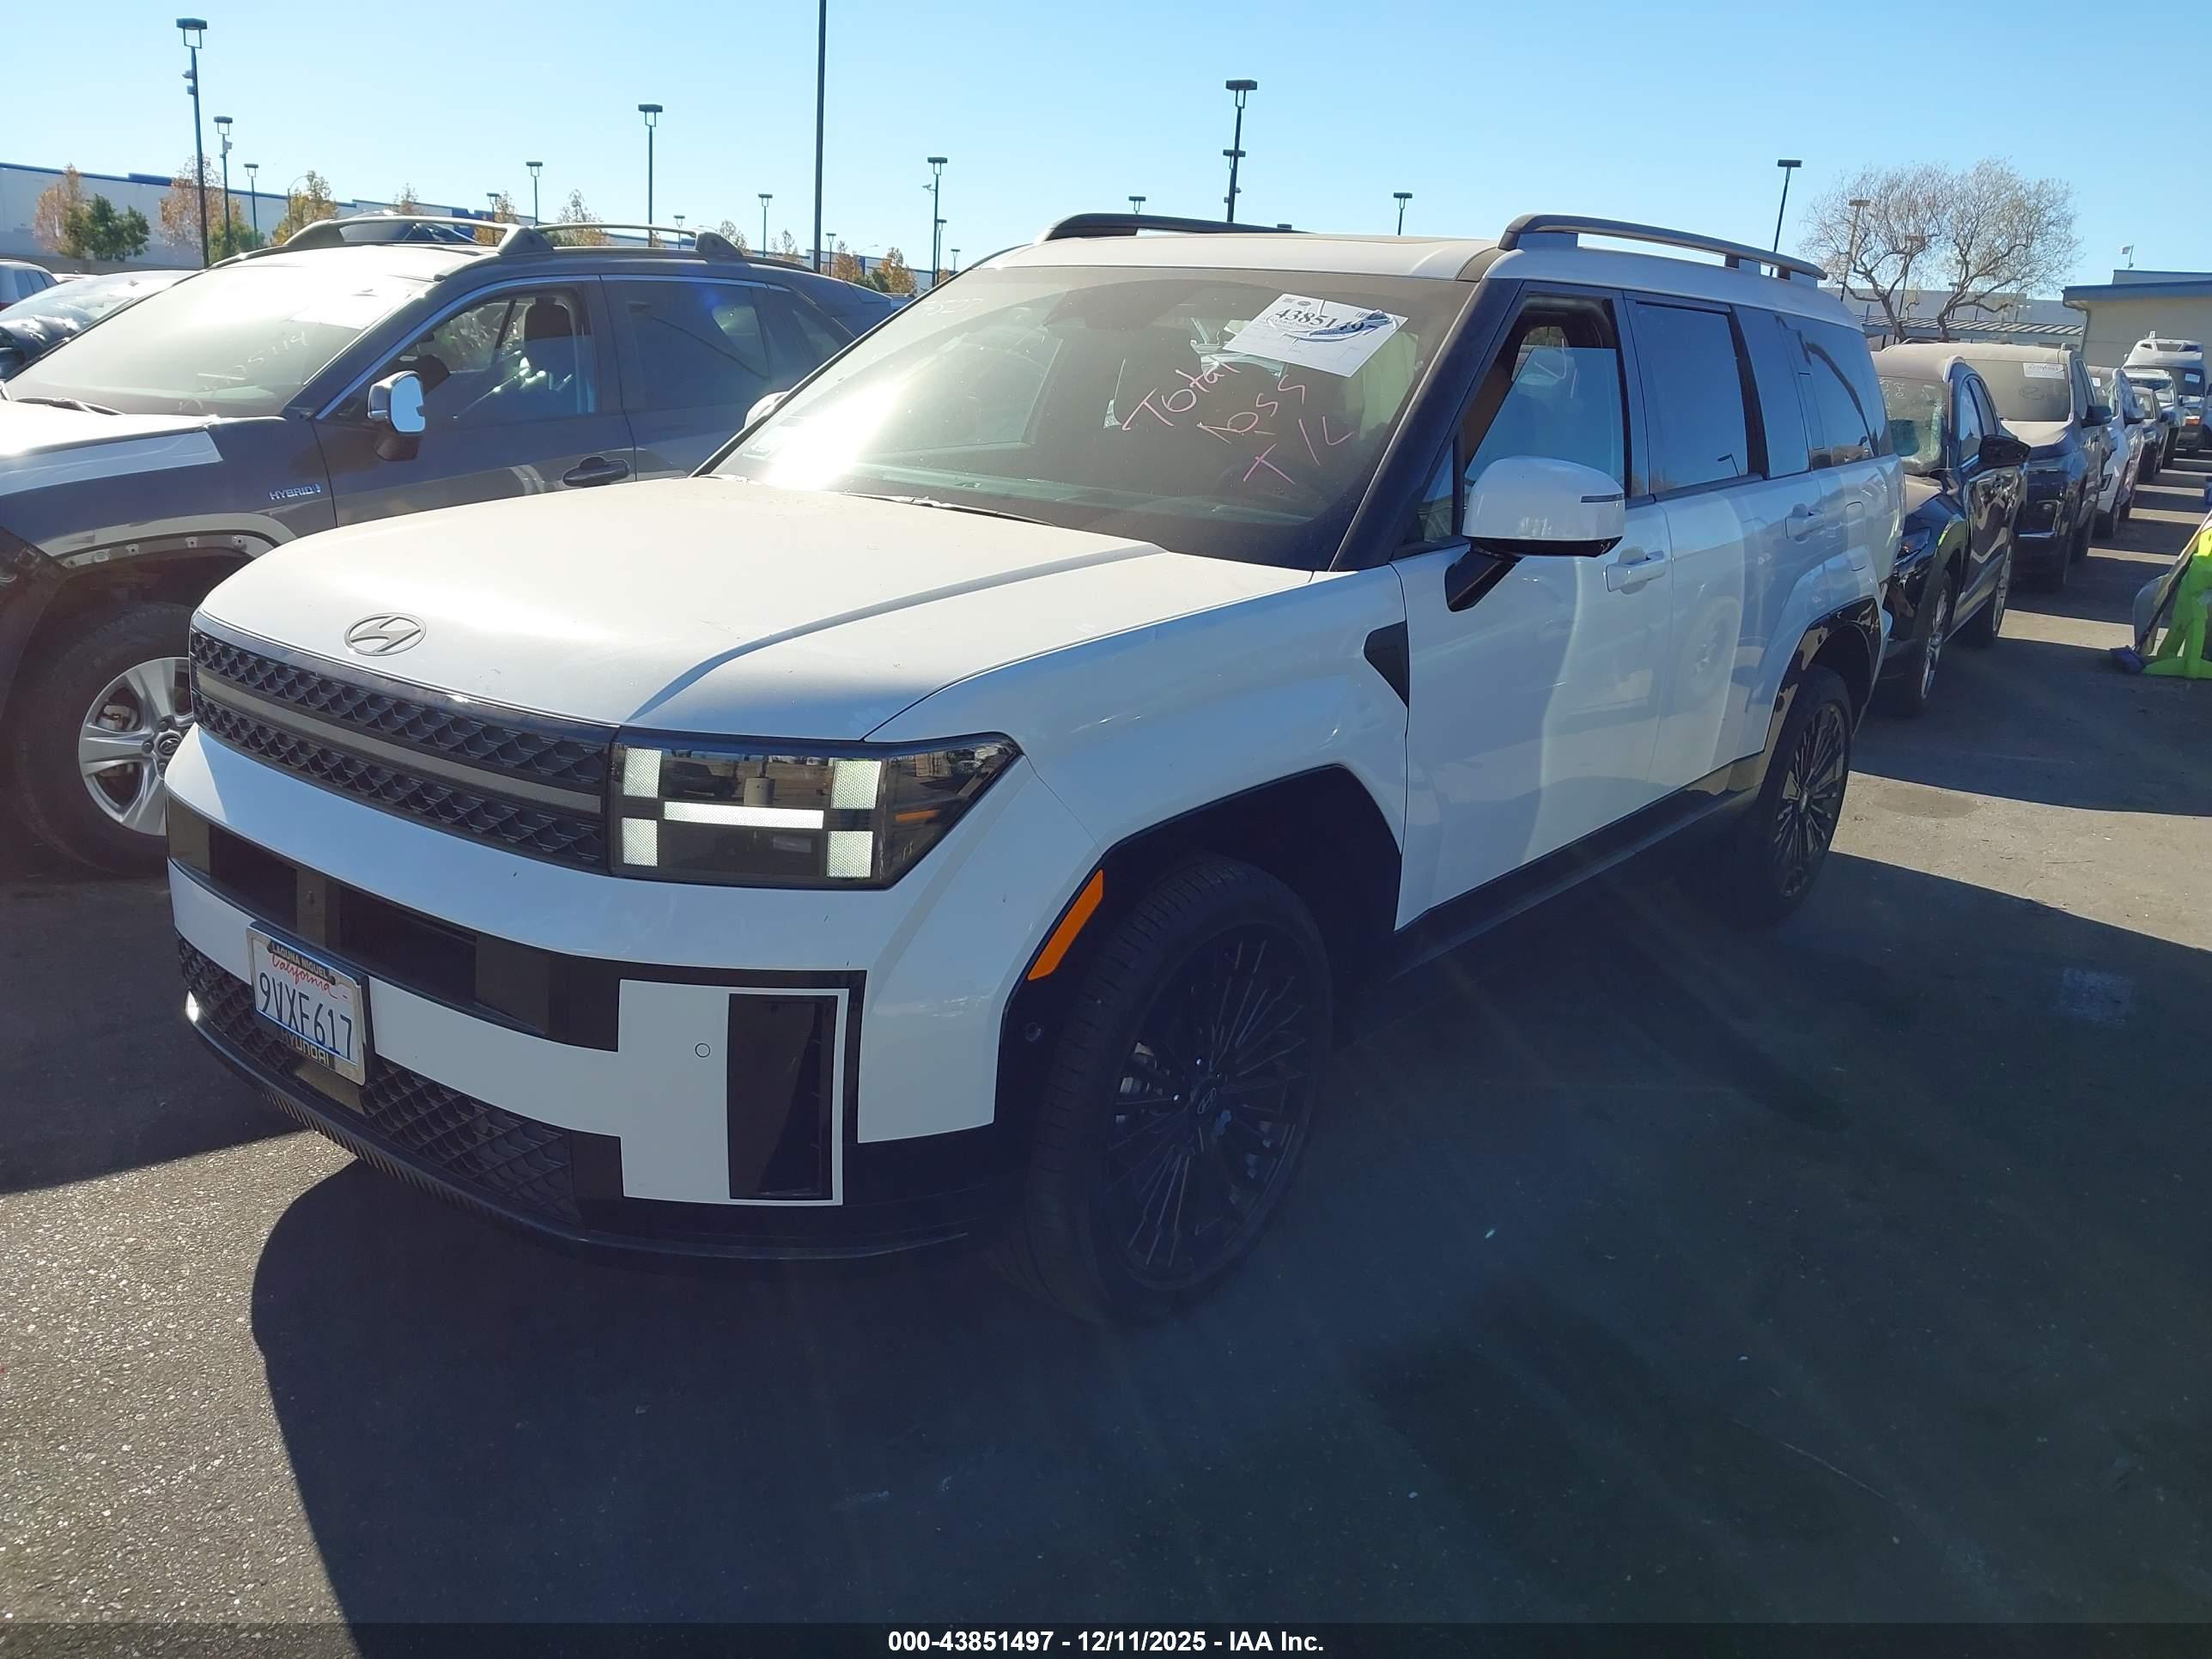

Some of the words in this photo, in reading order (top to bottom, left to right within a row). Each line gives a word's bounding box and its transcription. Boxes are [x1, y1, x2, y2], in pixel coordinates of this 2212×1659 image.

[268, 485, 314, 501] HYBRID
[271, 943, 301, 965] LAGUNA
[301, 955, 329, 978] MIGUEL
[271, 952, 338, 1000] California
[259, 972, 352, 1060] 9VXF617
[281, 1030, 330, 1067] HYUNDAI
